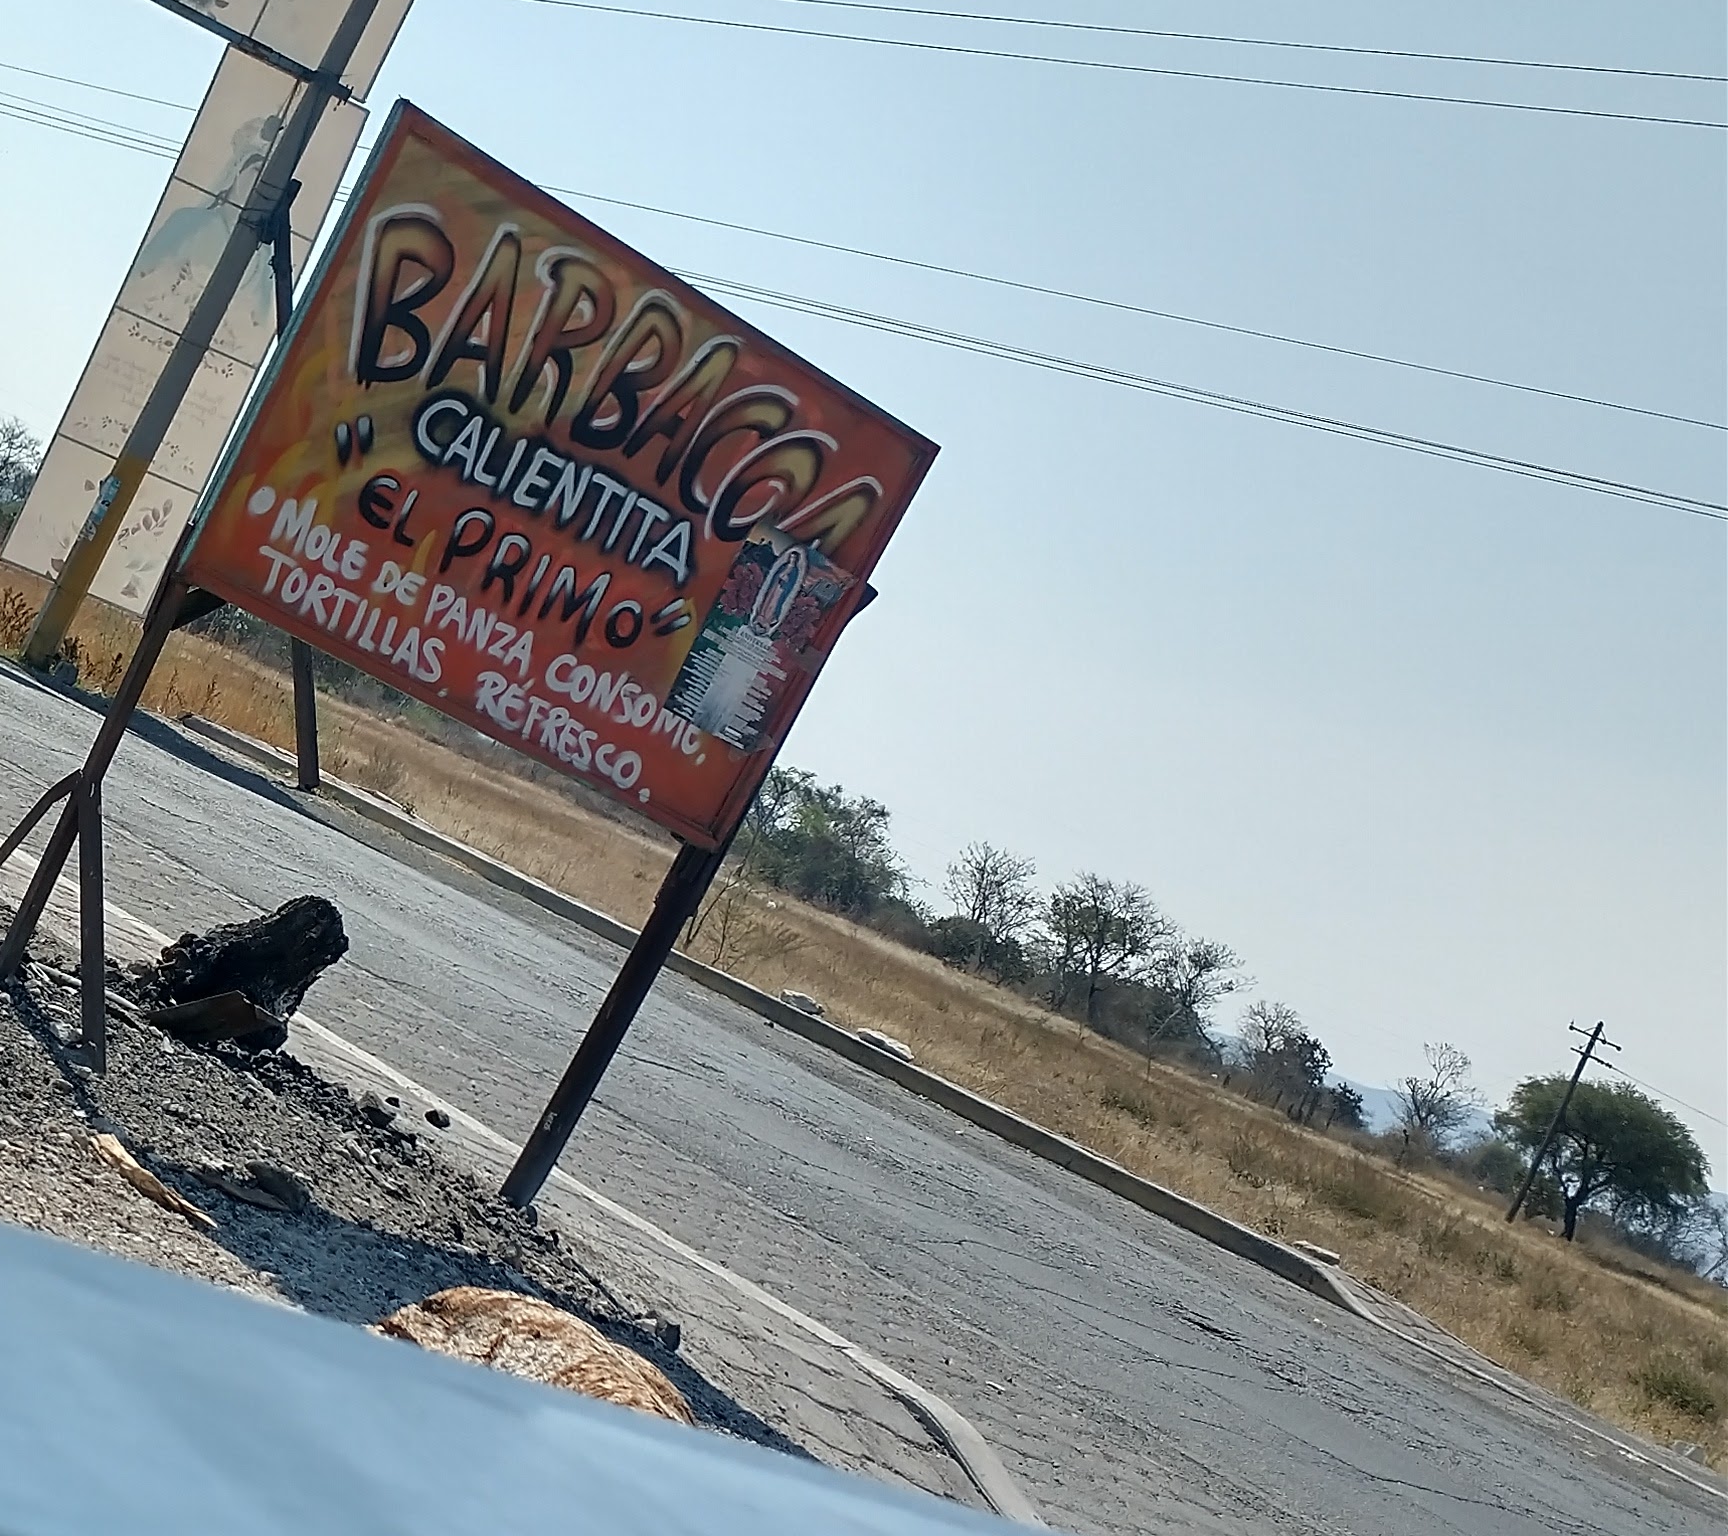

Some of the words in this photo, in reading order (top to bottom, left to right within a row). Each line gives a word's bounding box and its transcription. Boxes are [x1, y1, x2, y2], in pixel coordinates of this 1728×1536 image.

[348, 202, 883, 554] BARBACOA
[270, 497, 370, 580] MOLE
[372, 560, 426, 606] DE
[417, 398, 691, 582] CALIENTITA
